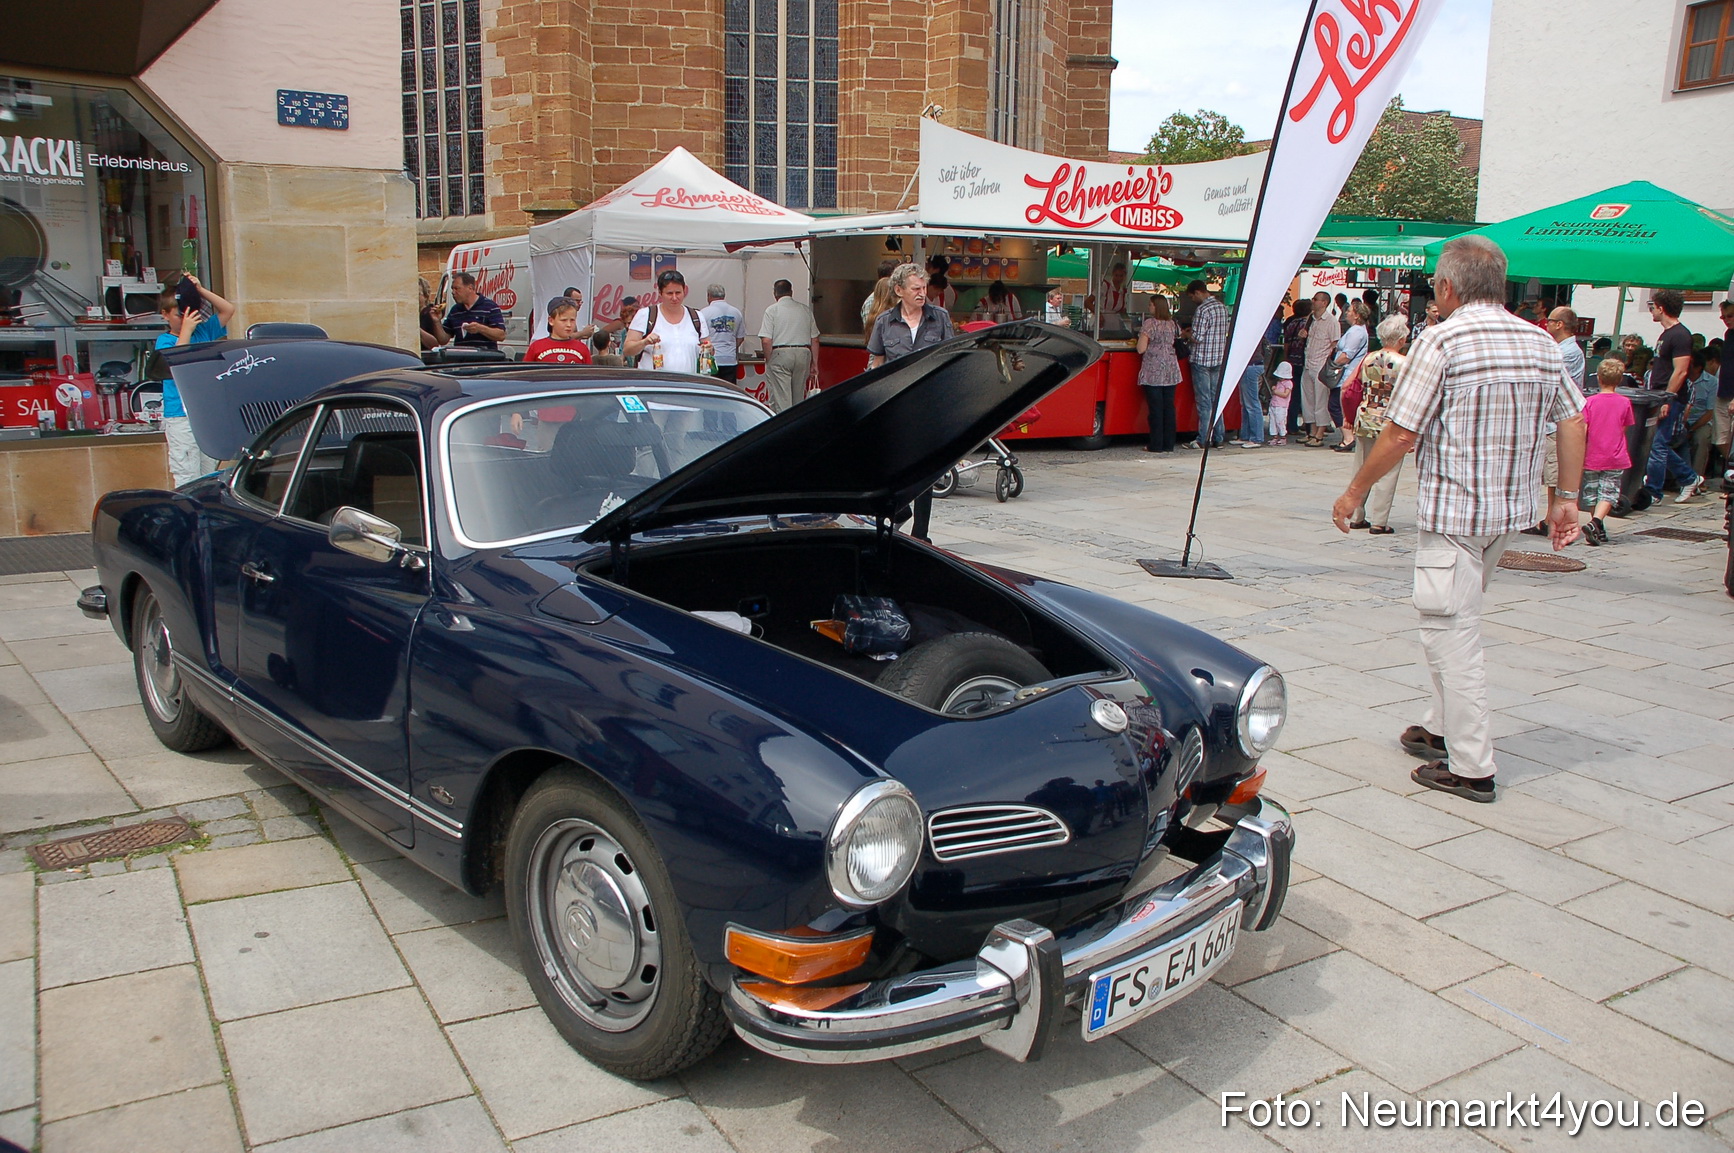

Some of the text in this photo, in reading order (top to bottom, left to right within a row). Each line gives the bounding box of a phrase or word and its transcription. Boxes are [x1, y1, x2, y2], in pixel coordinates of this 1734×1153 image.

[88, 153, 192, 173] Erlebnishaus.
[24, 175, 41, 184] Tag
[937, 165, 981, 183] Seit über
[632, 187, 763, 210] Lehmeier's
[953, 180, 1001, 200] 50 Jahren
[1023, 162, 1173, 228] Lehmeier's
[1203, 178, 1249, 201] Genuss und
[726, 203, 779, 216] IMBISS
[1119, 205, 1175, 228] IMBISS
[1218, 197, 1254, 217] Qualität!
[1524, 226, 1658, 238] Lammsbräu
[1550, 220, 1647, 229] Neumarkter
[1093, 1007, 1102, 1021] D
[1108, 966, 1149, 1018] FS
[1165, 941, 1197, 991] EA
[1202, 910, 1239, 968] 66H
